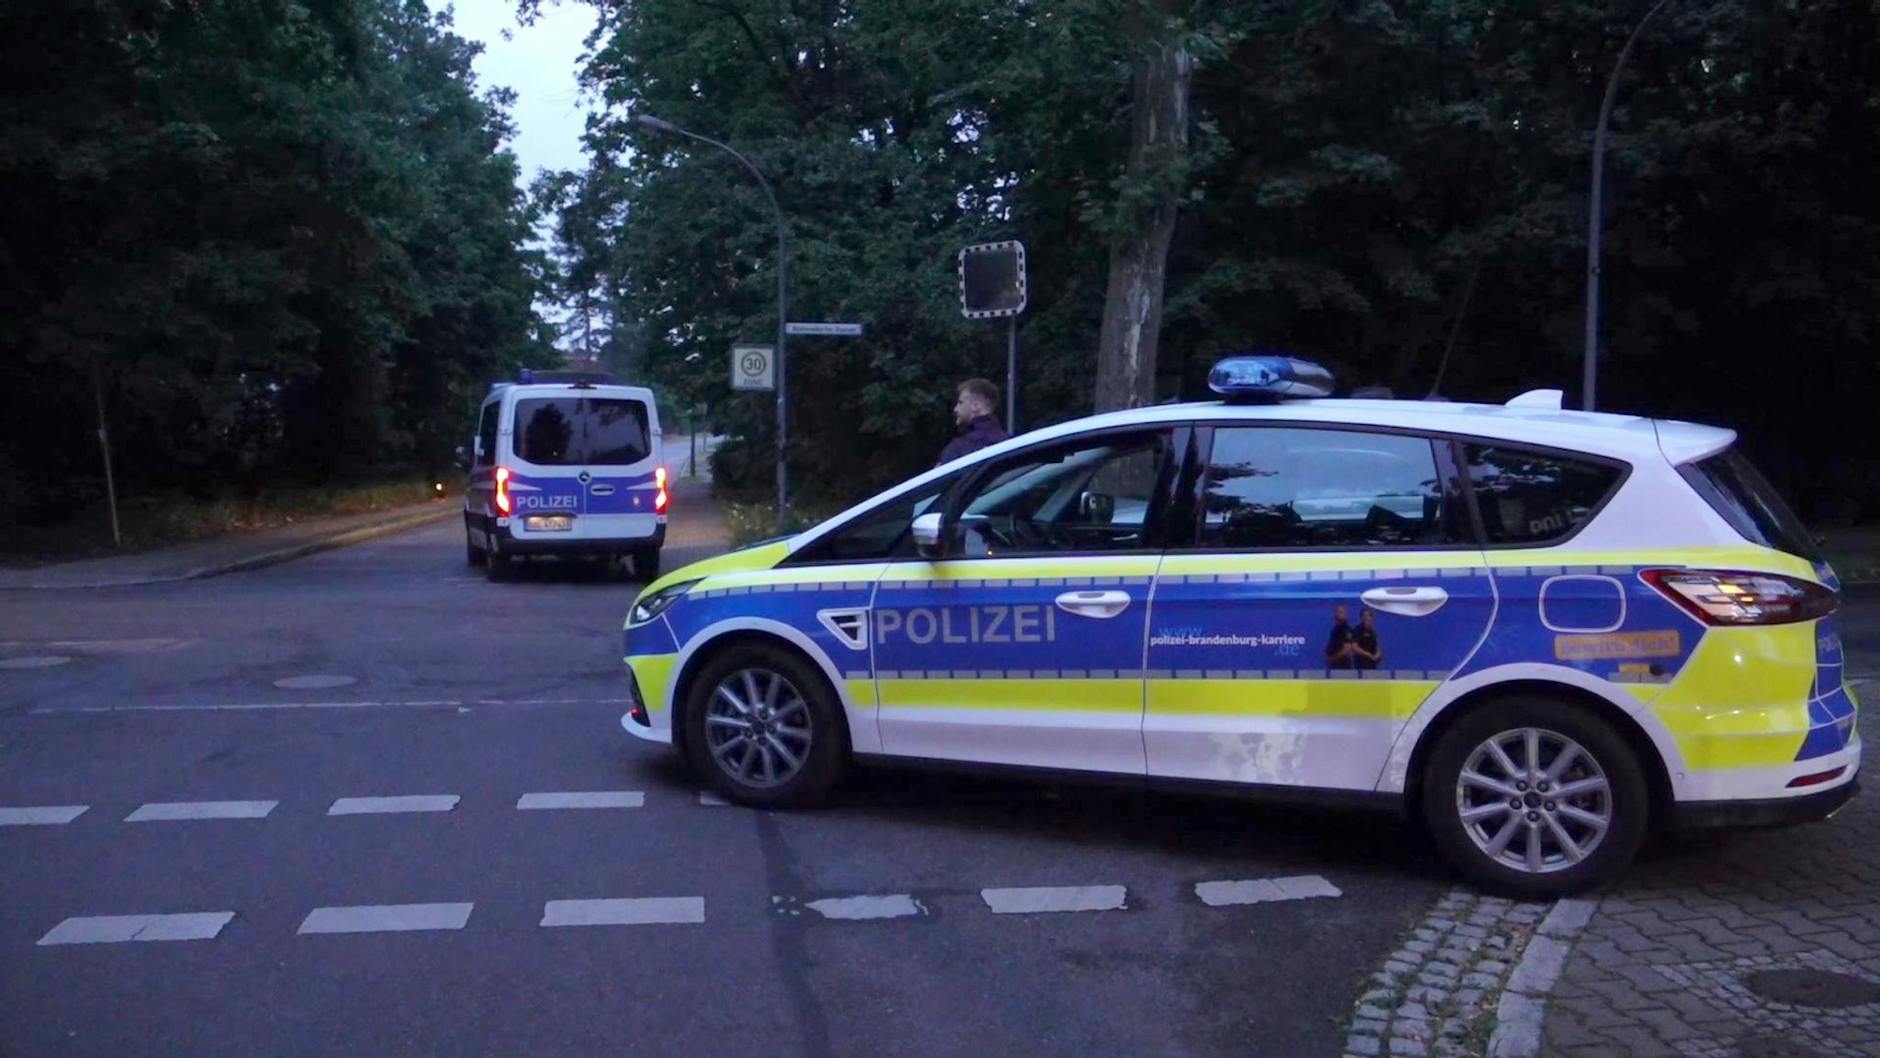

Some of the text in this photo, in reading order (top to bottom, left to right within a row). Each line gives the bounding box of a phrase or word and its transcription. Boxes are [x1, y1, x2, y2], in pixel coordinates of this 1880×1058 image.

[746, 358, 762, 370] 30
[516, 495, 577, 509] POLIZEI
[876, 605, 1056, 645] POLIZEI
[1158, 626, 1203, 637] www
[1150, 634, 1305, 647] polizei-brandenburg-karriere
